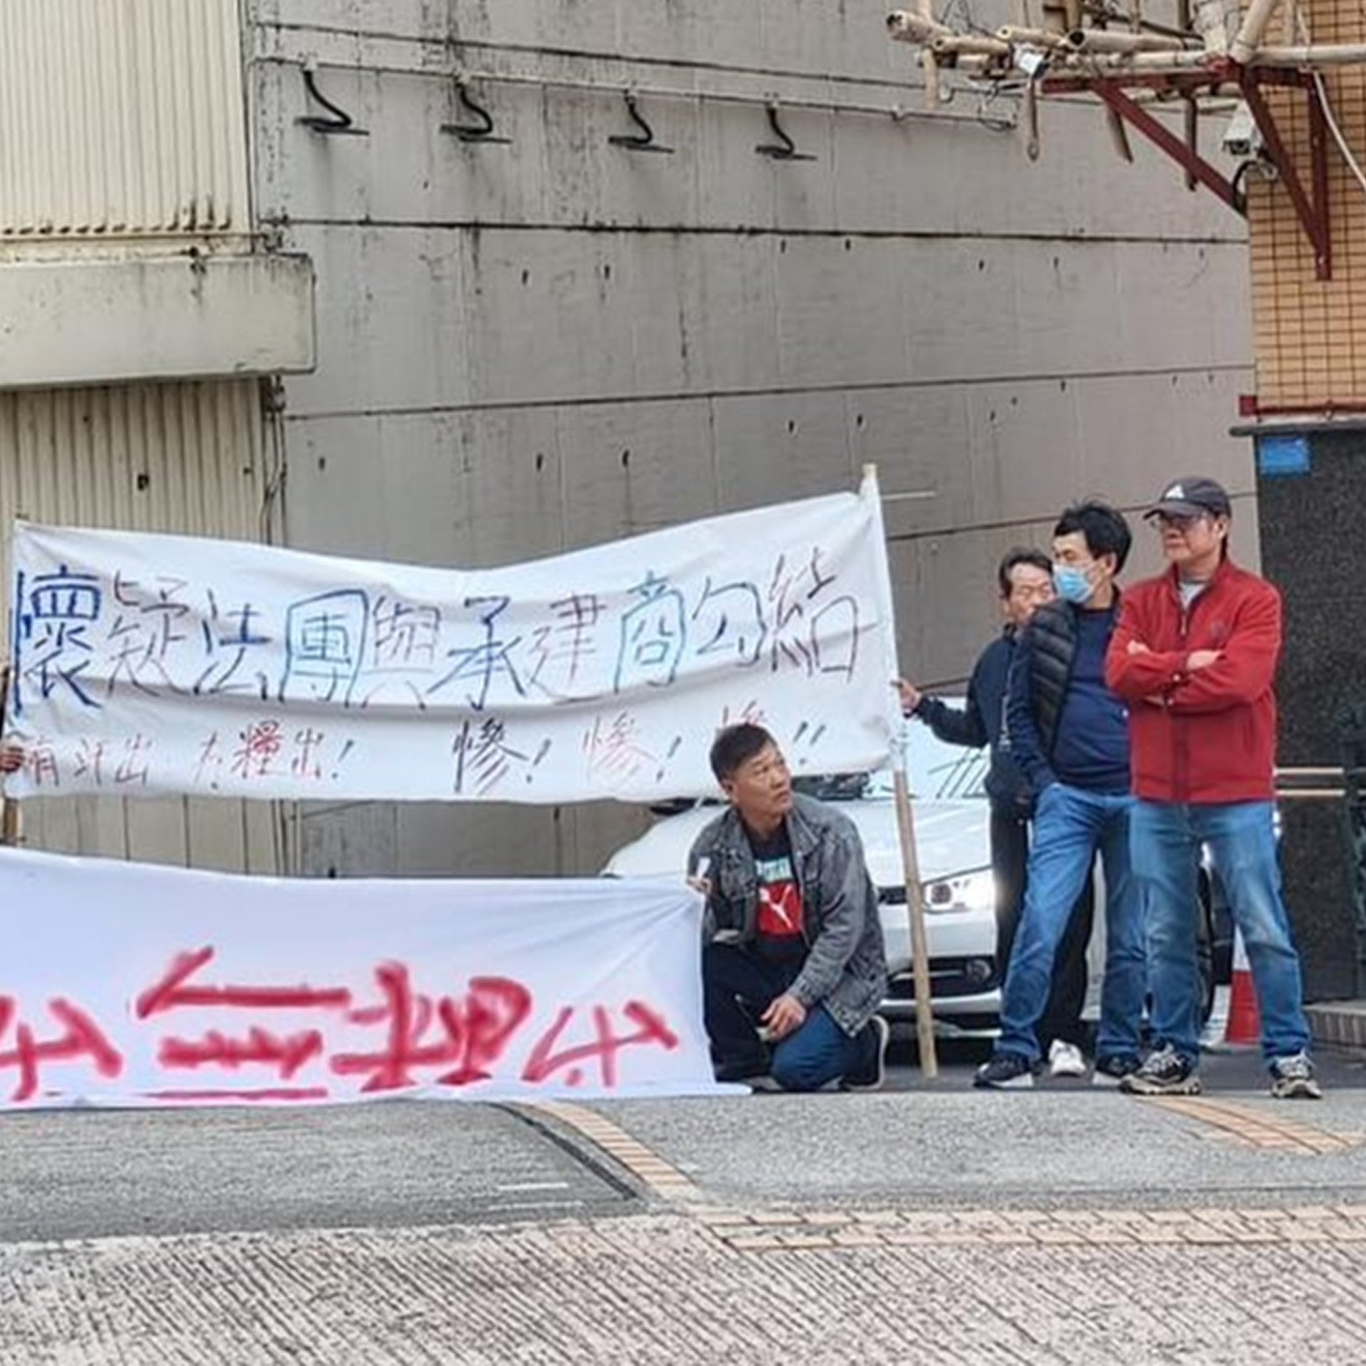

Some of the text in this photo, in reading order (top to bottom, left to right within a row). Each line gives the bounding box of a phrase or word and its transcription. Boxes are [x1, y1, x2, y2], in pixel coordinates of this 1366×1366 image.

[14, 546, 861, 715] 懷疑法團與承建商勾結
